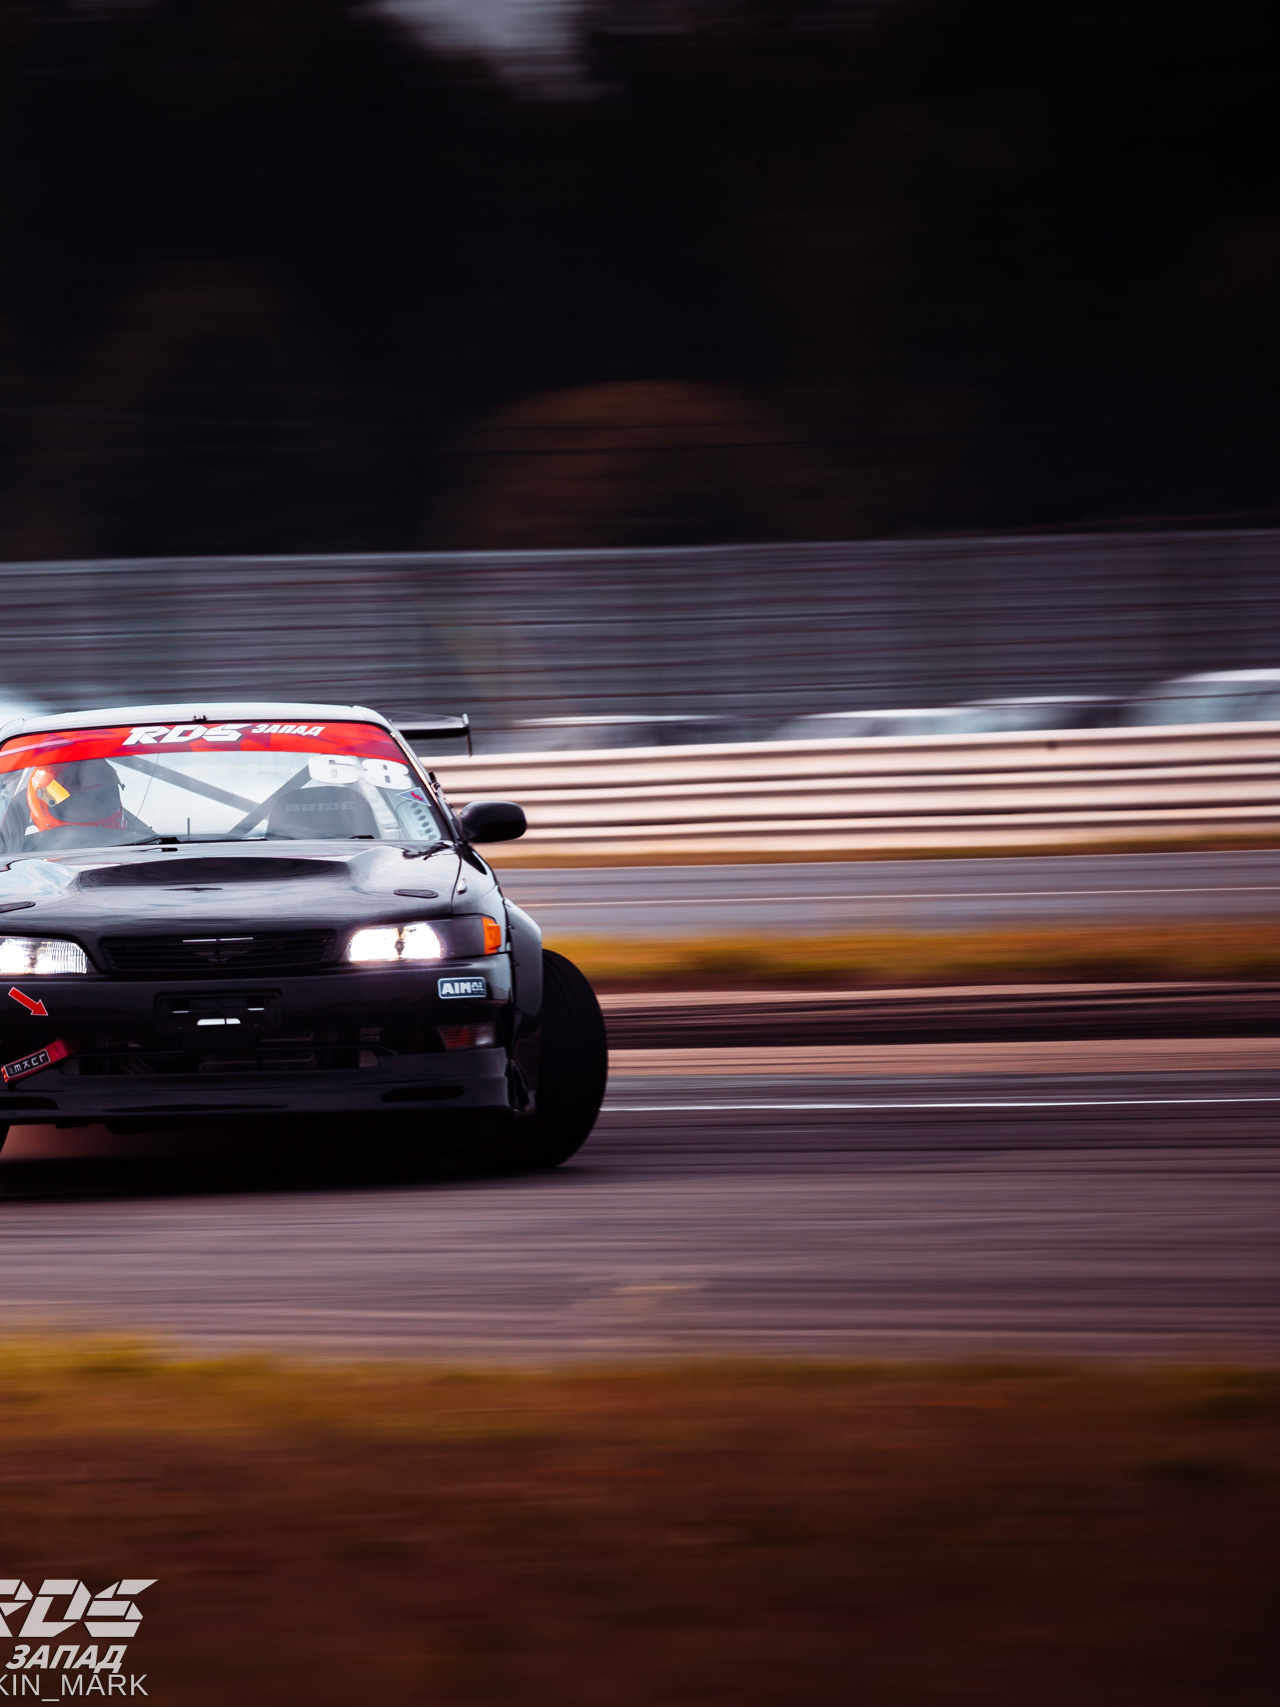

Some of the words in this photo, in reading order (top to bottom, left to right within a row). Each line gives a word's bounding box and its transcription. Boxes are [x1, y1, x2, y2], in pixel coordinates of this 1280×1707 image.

[122, 724, 252, 746] RDS
[251, 724, 325, 737] ЗАПАД
[308, 754, 412, 790] 68
[285, 801, 355, 812] BRIDE
